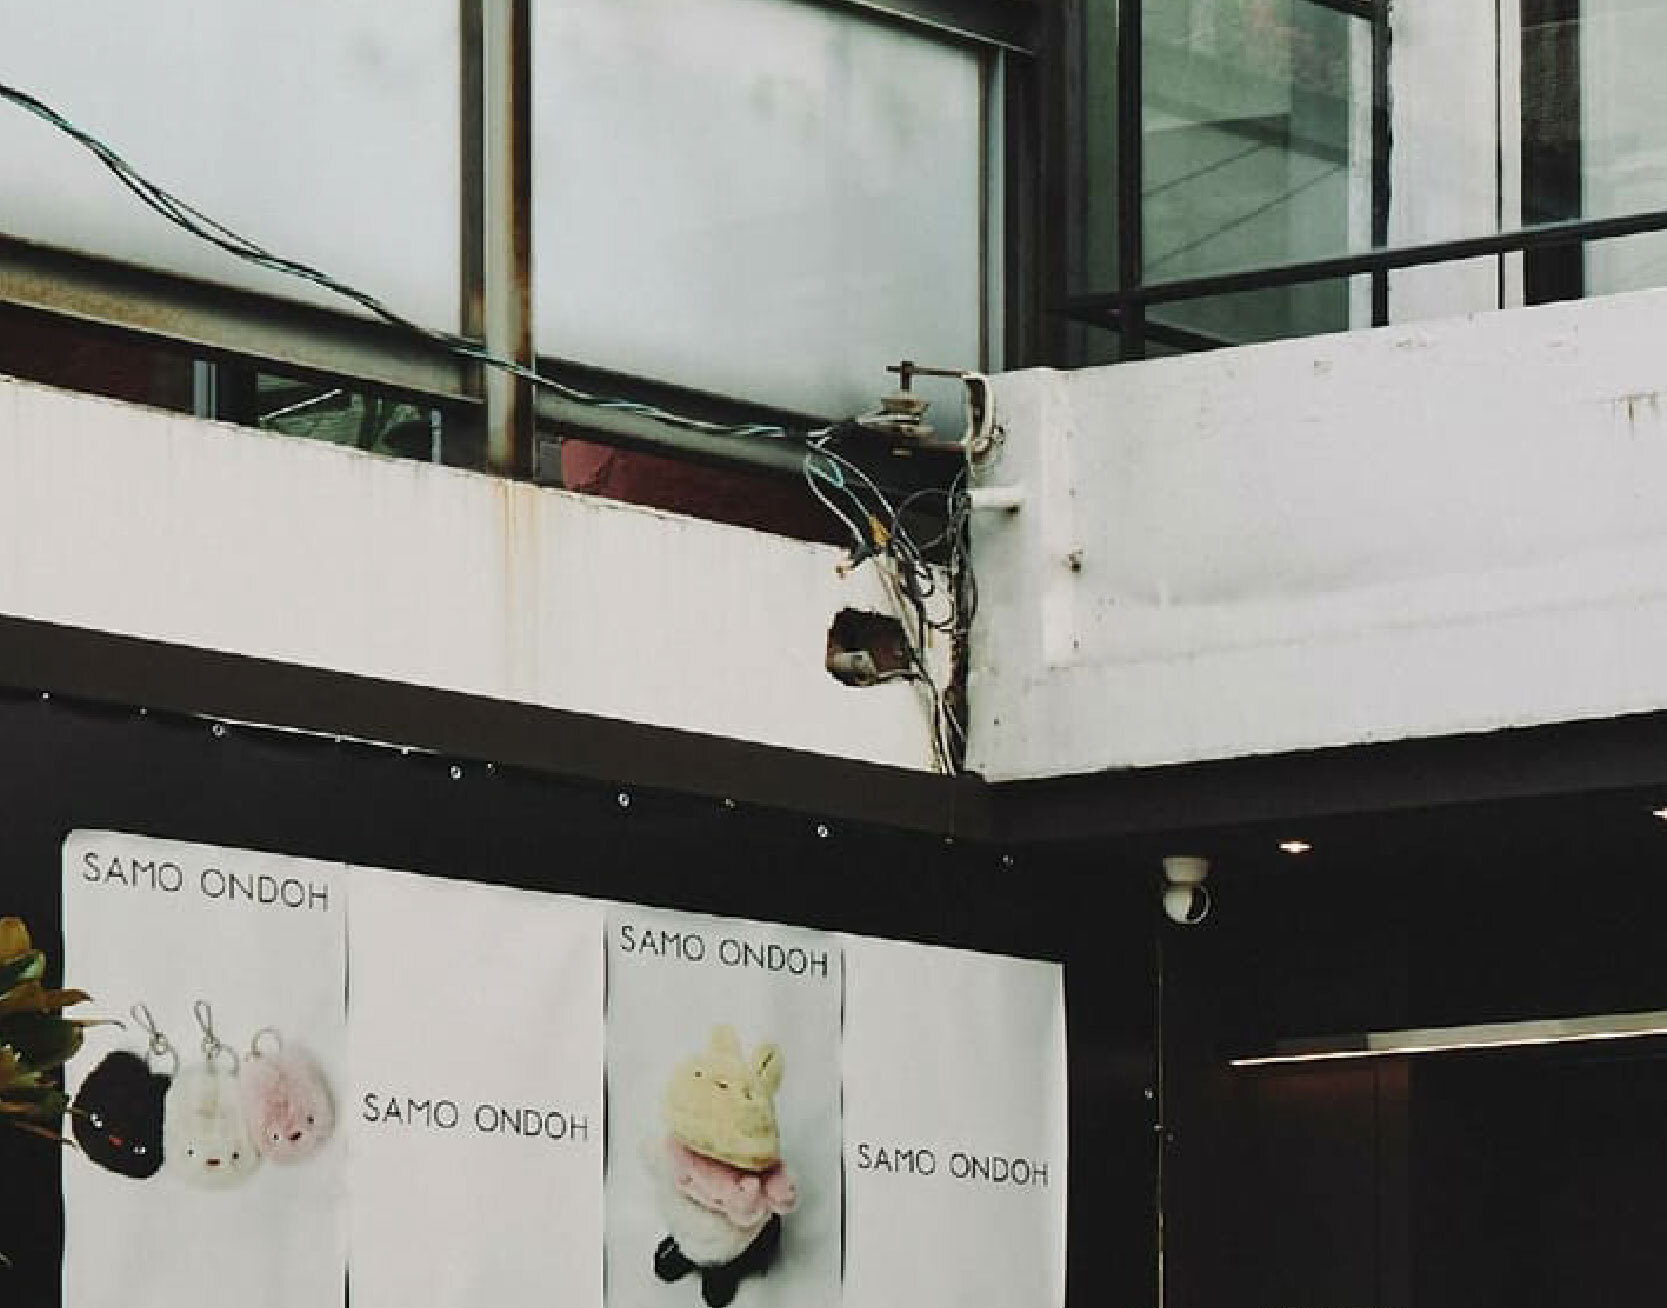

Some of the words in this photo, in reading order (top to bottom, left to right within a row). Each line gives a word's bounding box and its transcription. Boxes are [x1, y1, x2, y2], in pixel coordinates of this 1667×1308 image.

[82, 852, 183, 892] SAMO
[200, 866, 330, 913] ONDOH
[619, 925, 706, 962] SAMO
[718, 937, 828, 979] ONDOH
[362, 1092, 459, 1129] SAMO
[473, 1104, 588, 1141] ONDOH
[857, 1144, 936, 1176] SAMO
[948, 1151, 1049, 1187] ONDOH
